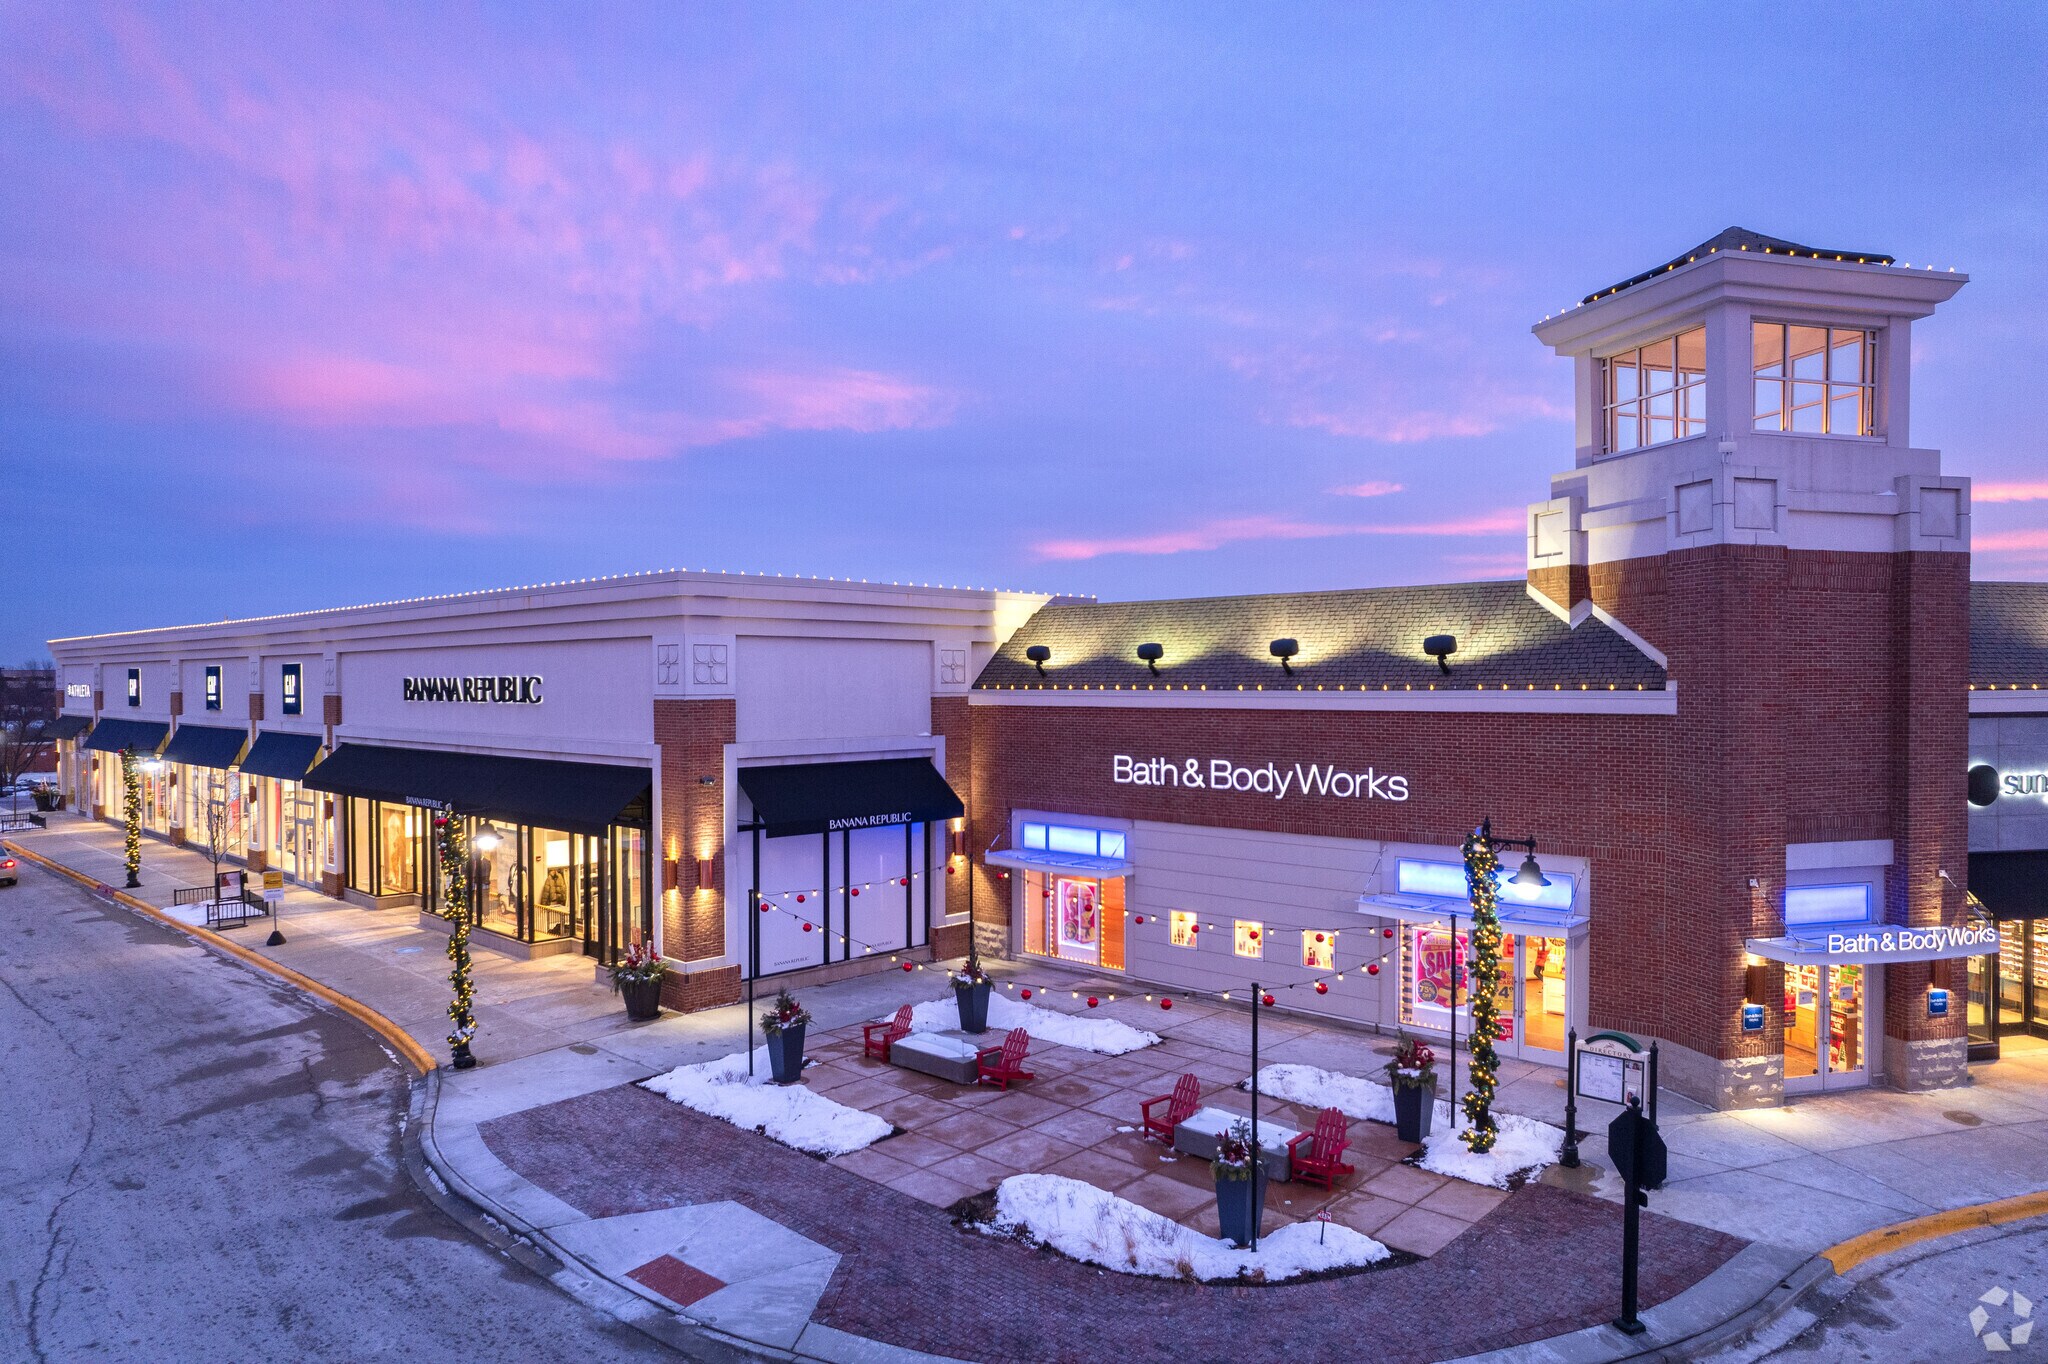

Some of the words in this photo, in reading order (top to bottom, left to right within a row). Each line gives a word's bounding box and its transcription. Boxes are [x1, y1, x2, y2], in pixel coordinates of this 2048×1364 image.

[403, 677, 463, 702] BANANA
[463, 676, 543, 704] REPUBLIC
[1113, 754, 1178, 786] Bath
[1182, 758, 1206, 789] &
[1210, 759, 1293, 800] Body
[1295, 763, 1409, 801] Works
[2003, 774, 2048, 795] sun
[829, 816, 868, 830] BANANA
[869, 812, 912, 825] REPUBLIC
[1828, 933, 1878, 954] Bath
[1880, 932, 1897, 951] &
[1898, 929, 1946, 952] Body
[1946, 925, 1996, 947] Works
[1589, 1046, 1632, 1059] DIRECTORY
